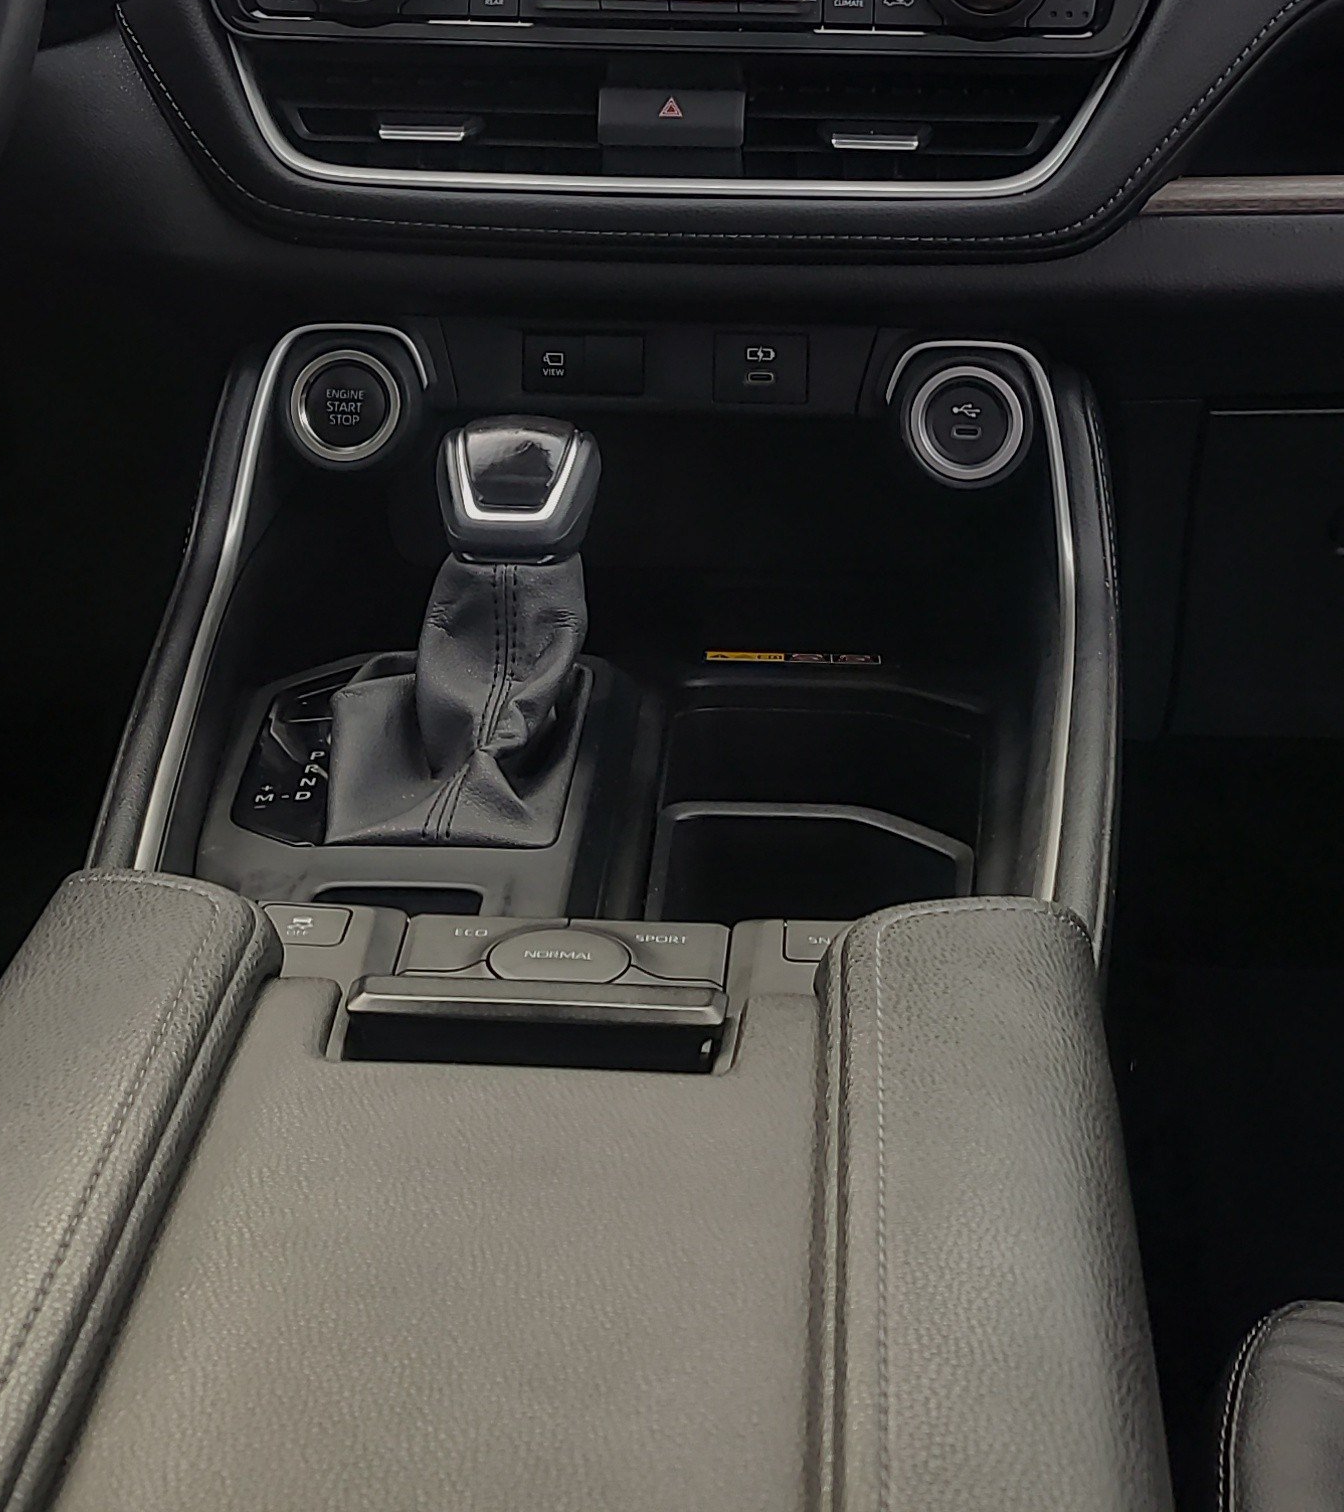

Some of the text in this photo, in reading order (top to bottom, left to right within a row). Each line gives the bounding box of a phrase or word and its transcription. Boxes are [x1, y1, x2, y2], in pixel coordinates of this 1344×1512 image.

[542, 368, 565, 377] VIEW
[326, 388, 365, 400] ENGINE
[327, 400, 362, 413] START
[329, 413, 360, 426] STOP
[310, 750, 326, 761] P
[299, 776, 317, 787] N
[255, 792, 275, 803] M
[294, 790, 313, 802] D
[454, 928, 488, 937] ECO
[635, 934, 687, 945] SPORT
[523, 949, 593, 961] NORMAL
